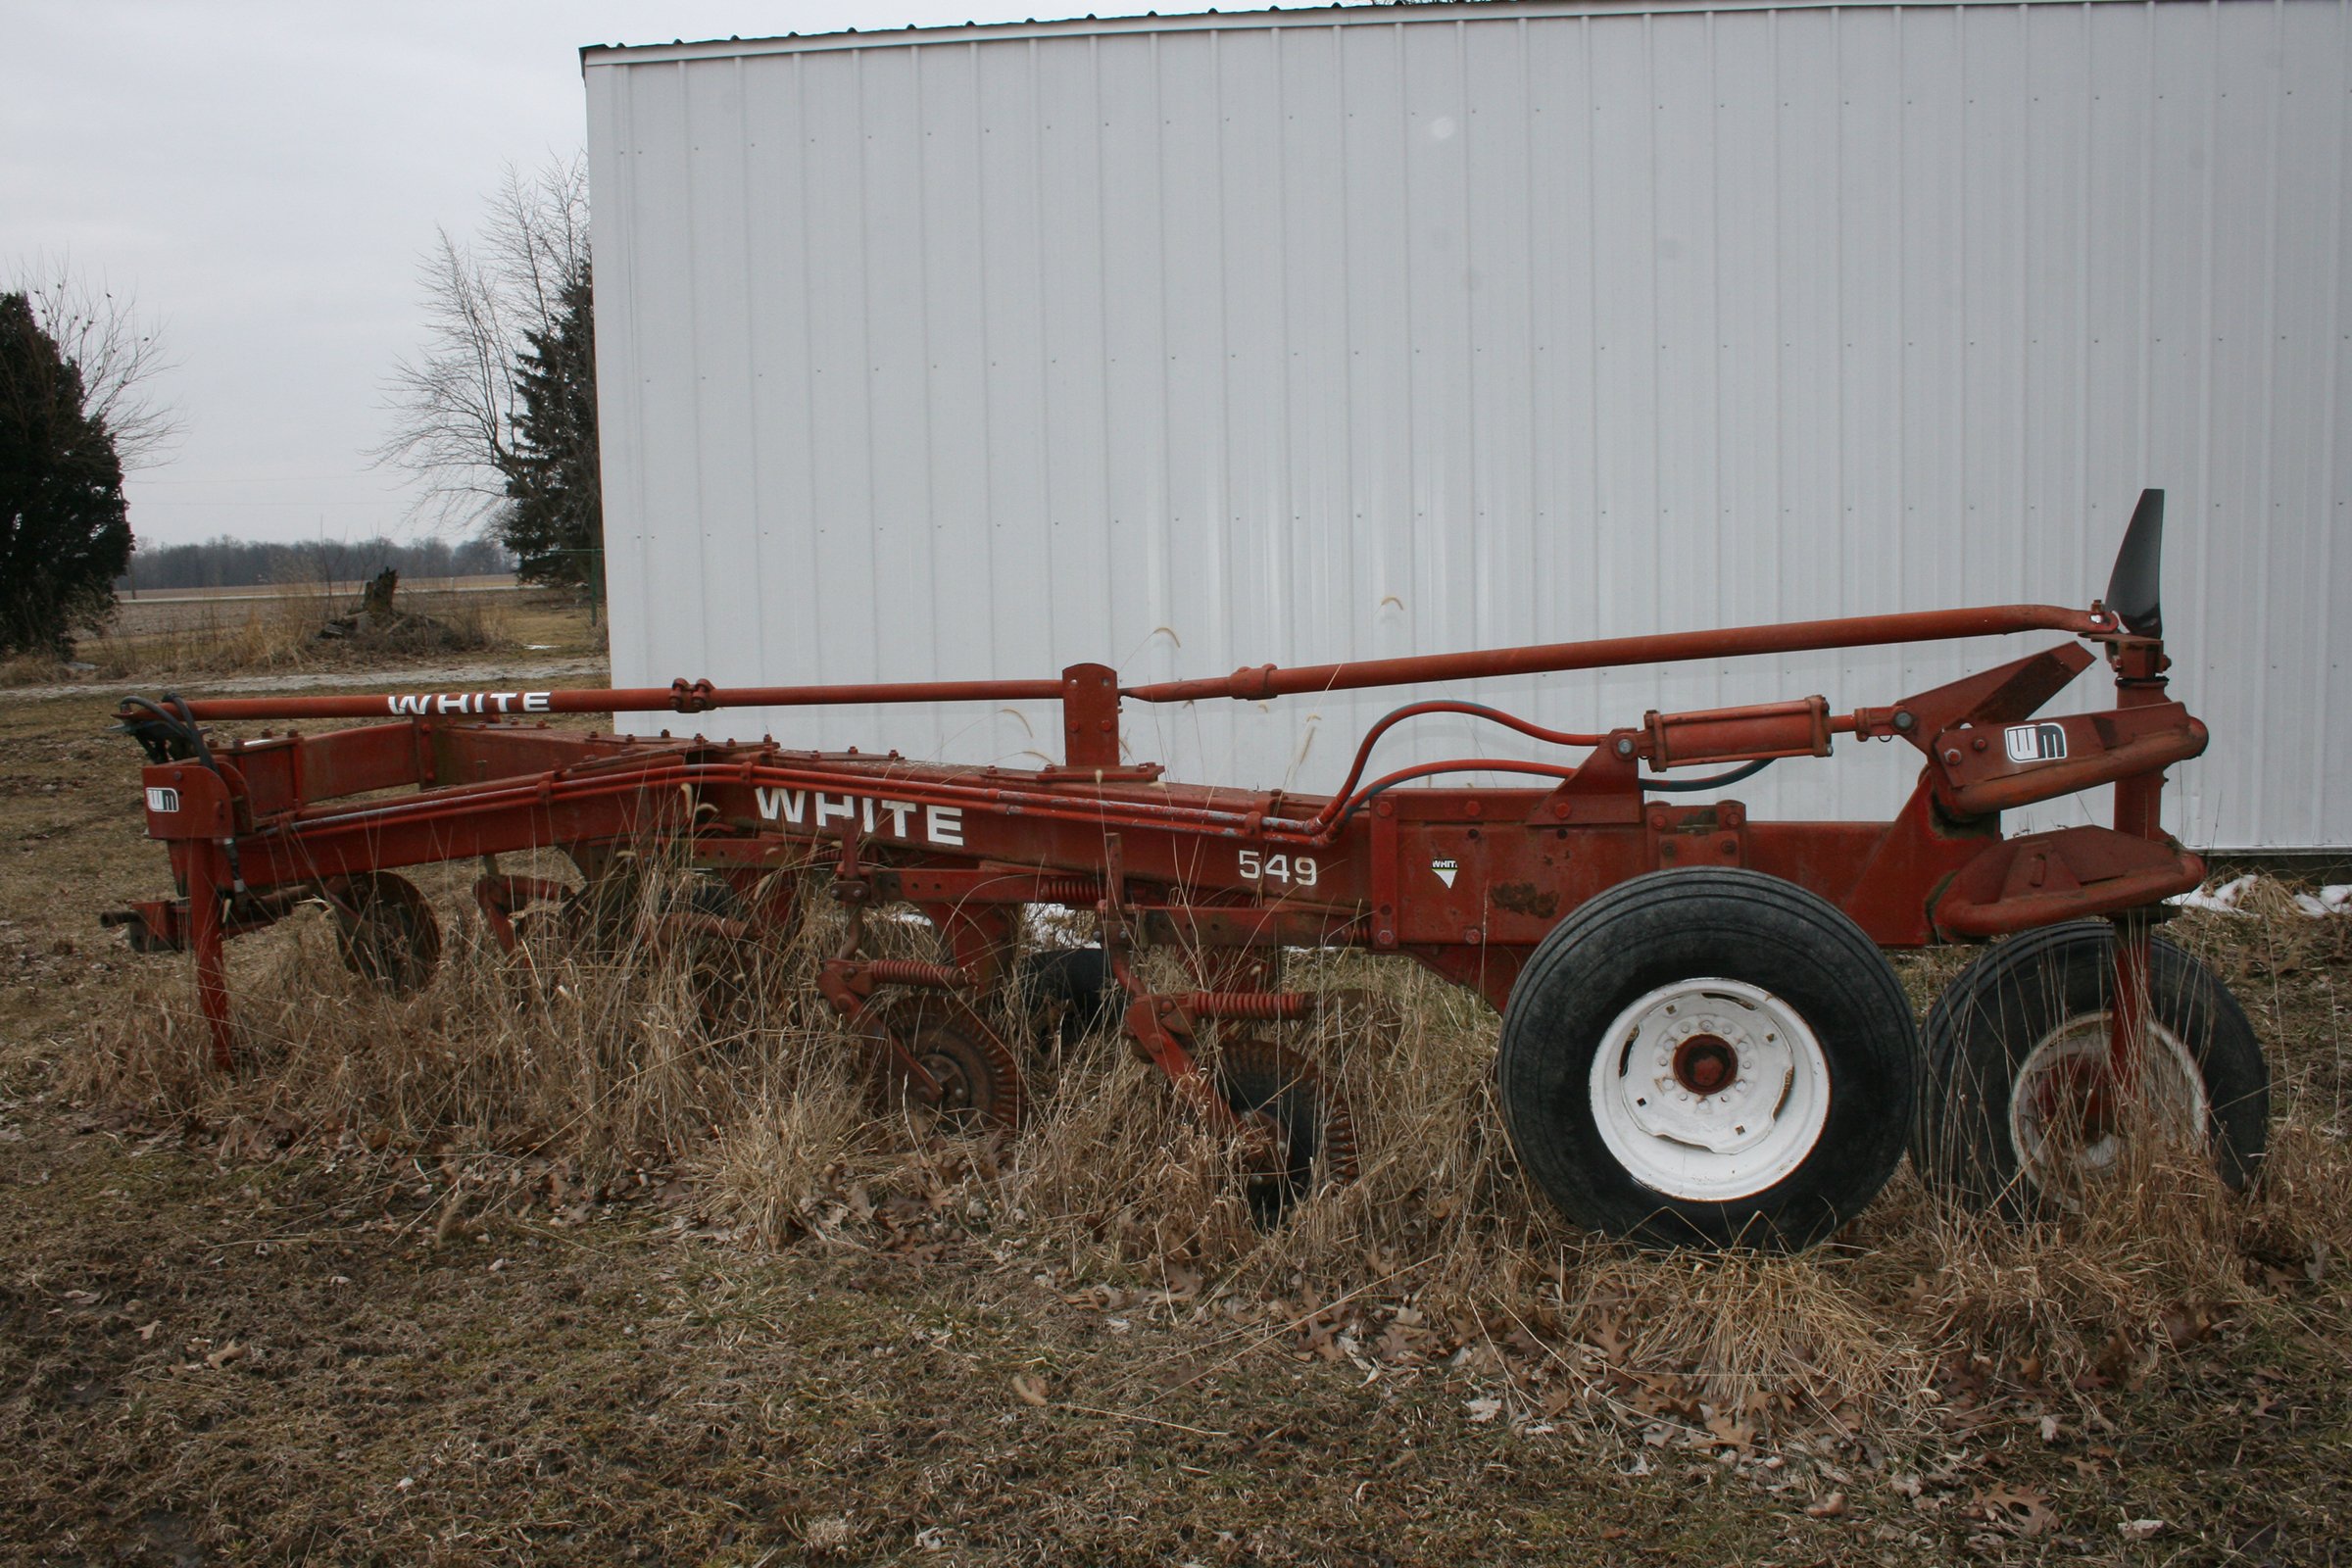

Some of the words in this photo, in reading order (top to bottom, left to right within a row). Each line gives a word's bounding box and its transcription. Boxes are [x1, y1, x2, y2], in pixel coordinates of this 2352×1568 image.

[388, 692, 551, 714] WHITE
[754, 786, 964, 846] WHITE
[1239, 850, 1317, 886] 549
